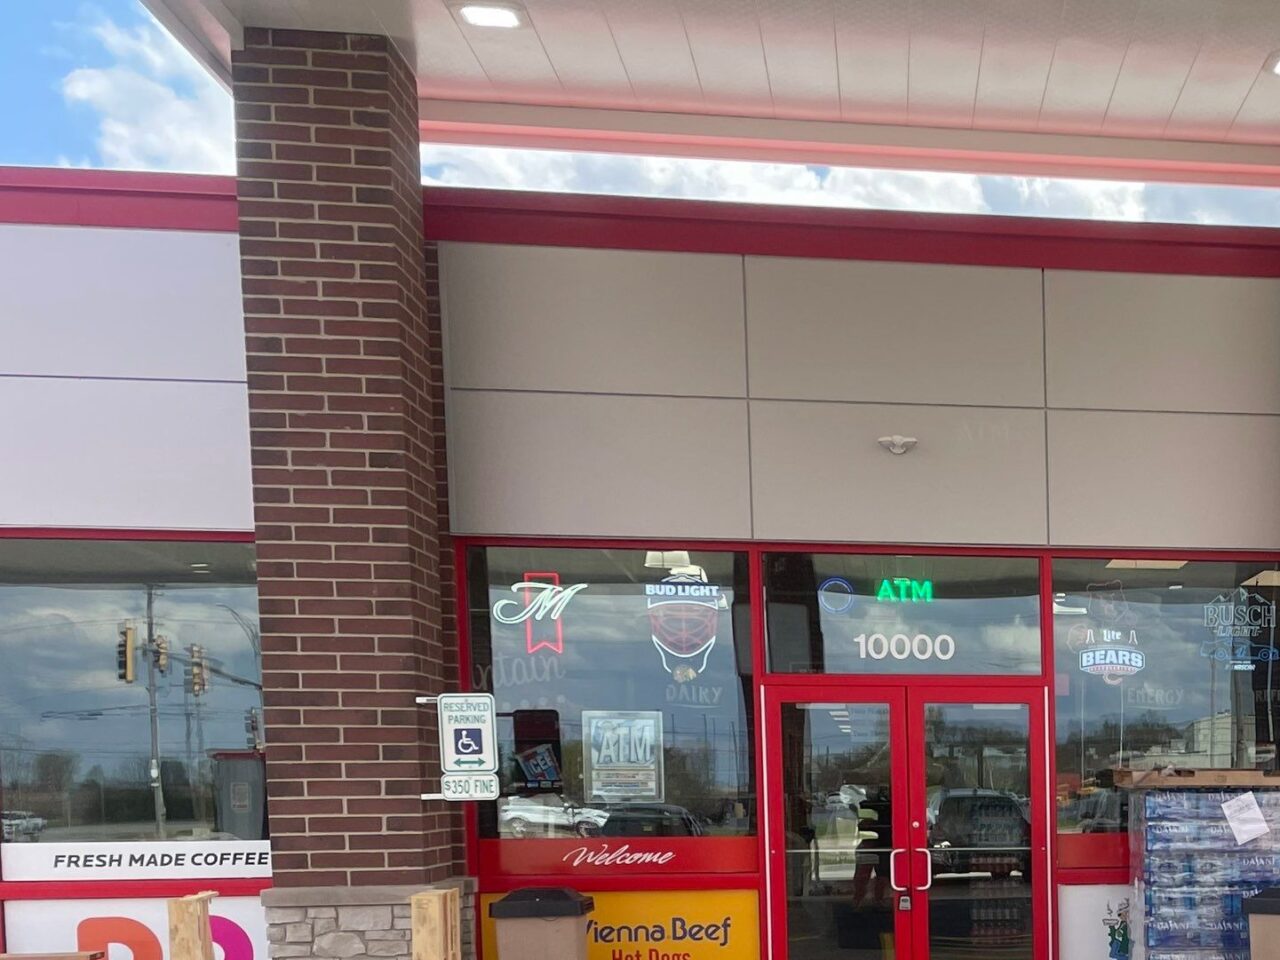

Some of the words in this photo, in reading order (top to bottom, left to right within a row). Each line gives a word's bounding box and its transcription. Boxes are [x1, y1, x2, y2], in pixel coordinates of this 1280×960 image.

[645, 584, 677, 596] BUD
[678, 585, 719, 597] LIGHT
[877, 577, 933, 602] ATM
[1203, 605, 1276, 628] BUSCH
[1103, 629, 1122, 642] Lite
[853, 633, 955, 660] 10000
[1081, 650, 1143, 668] BEARS
[443, 702, 489, 712] RESERVED
[448, 715, 487, 724] PARKING
[597, 726, 652, 764] ATM
[444, 780, 471, 794] $350
[474, 779, 495, 794] FINE
[54, 854, 122, 868] FRESH
[128, 853, 186, 867] MADE
[191, 852, 269, 866] COFFEE
[562, 844, 676, 866] Welcome
[671, 916, 732, 947] Beef
